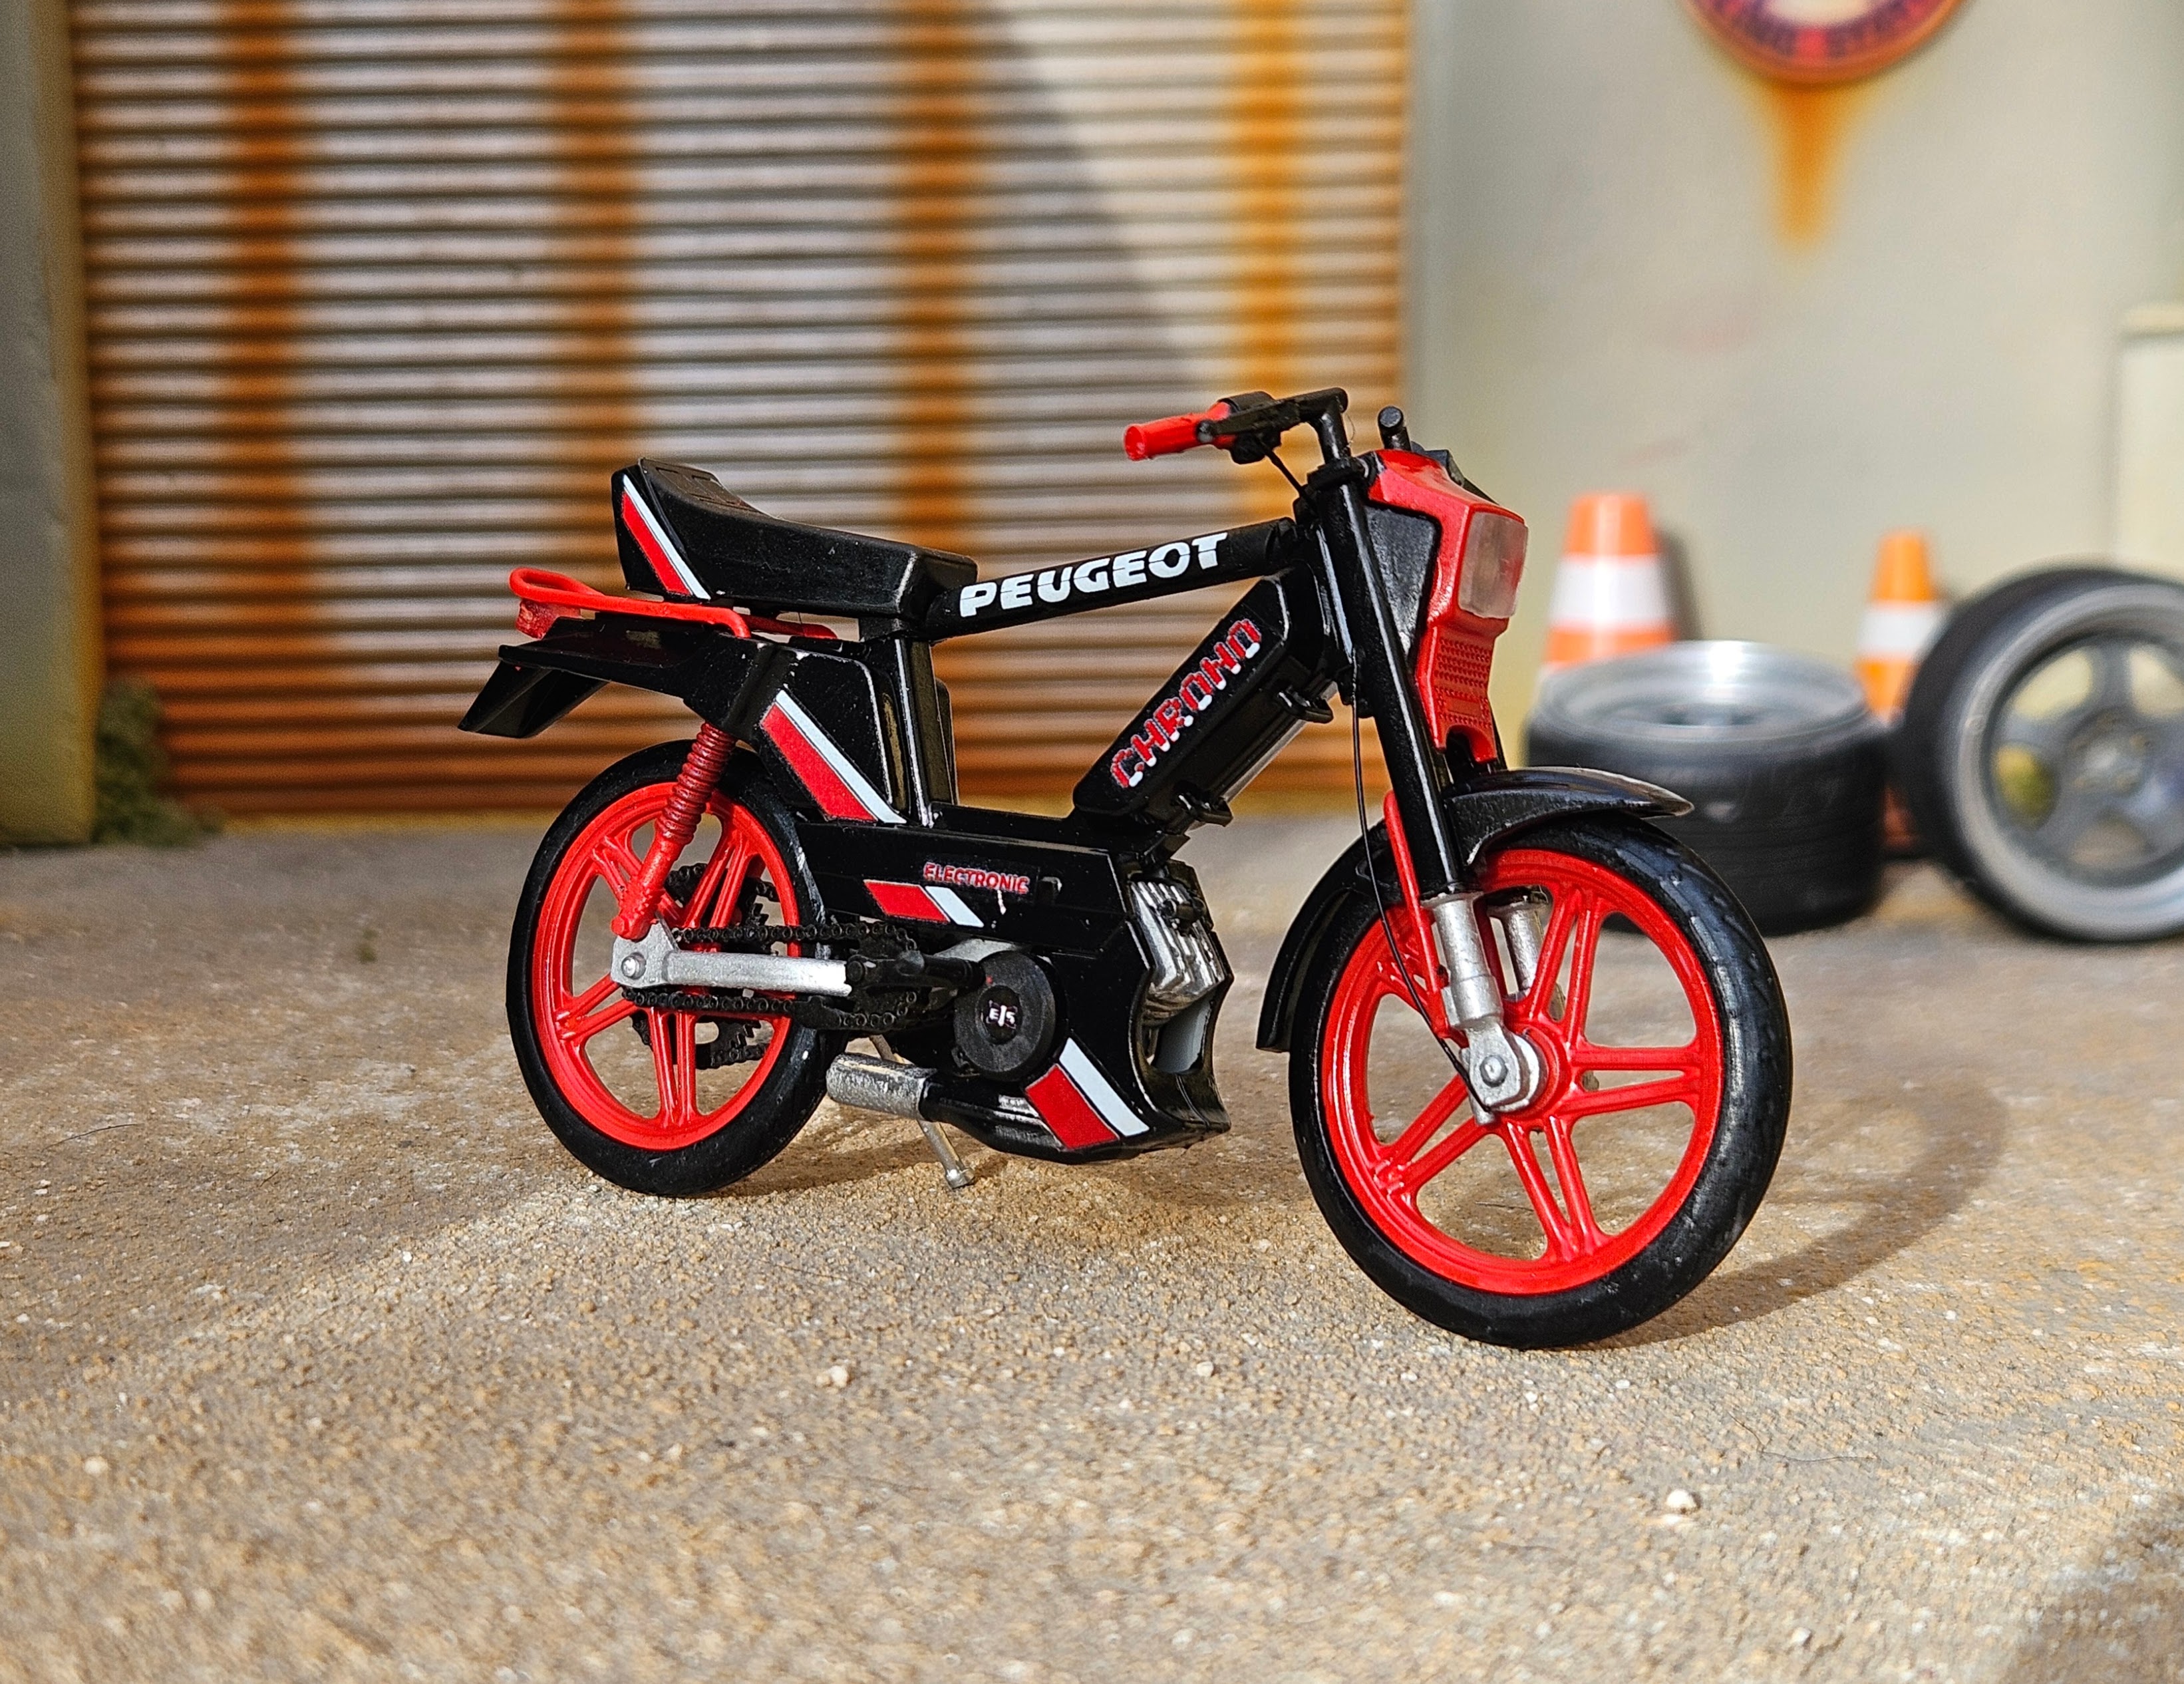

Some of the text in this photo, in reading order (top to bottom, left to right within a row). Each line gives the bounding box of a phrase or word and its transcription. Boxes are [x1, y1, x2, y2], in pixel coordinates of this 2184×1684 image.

[959, 532, 1228, 617] PEUGEOT
[1110, 619, 1262, 788] CHRONO
[923, 862, 1030, 894] ELECTRONIC
